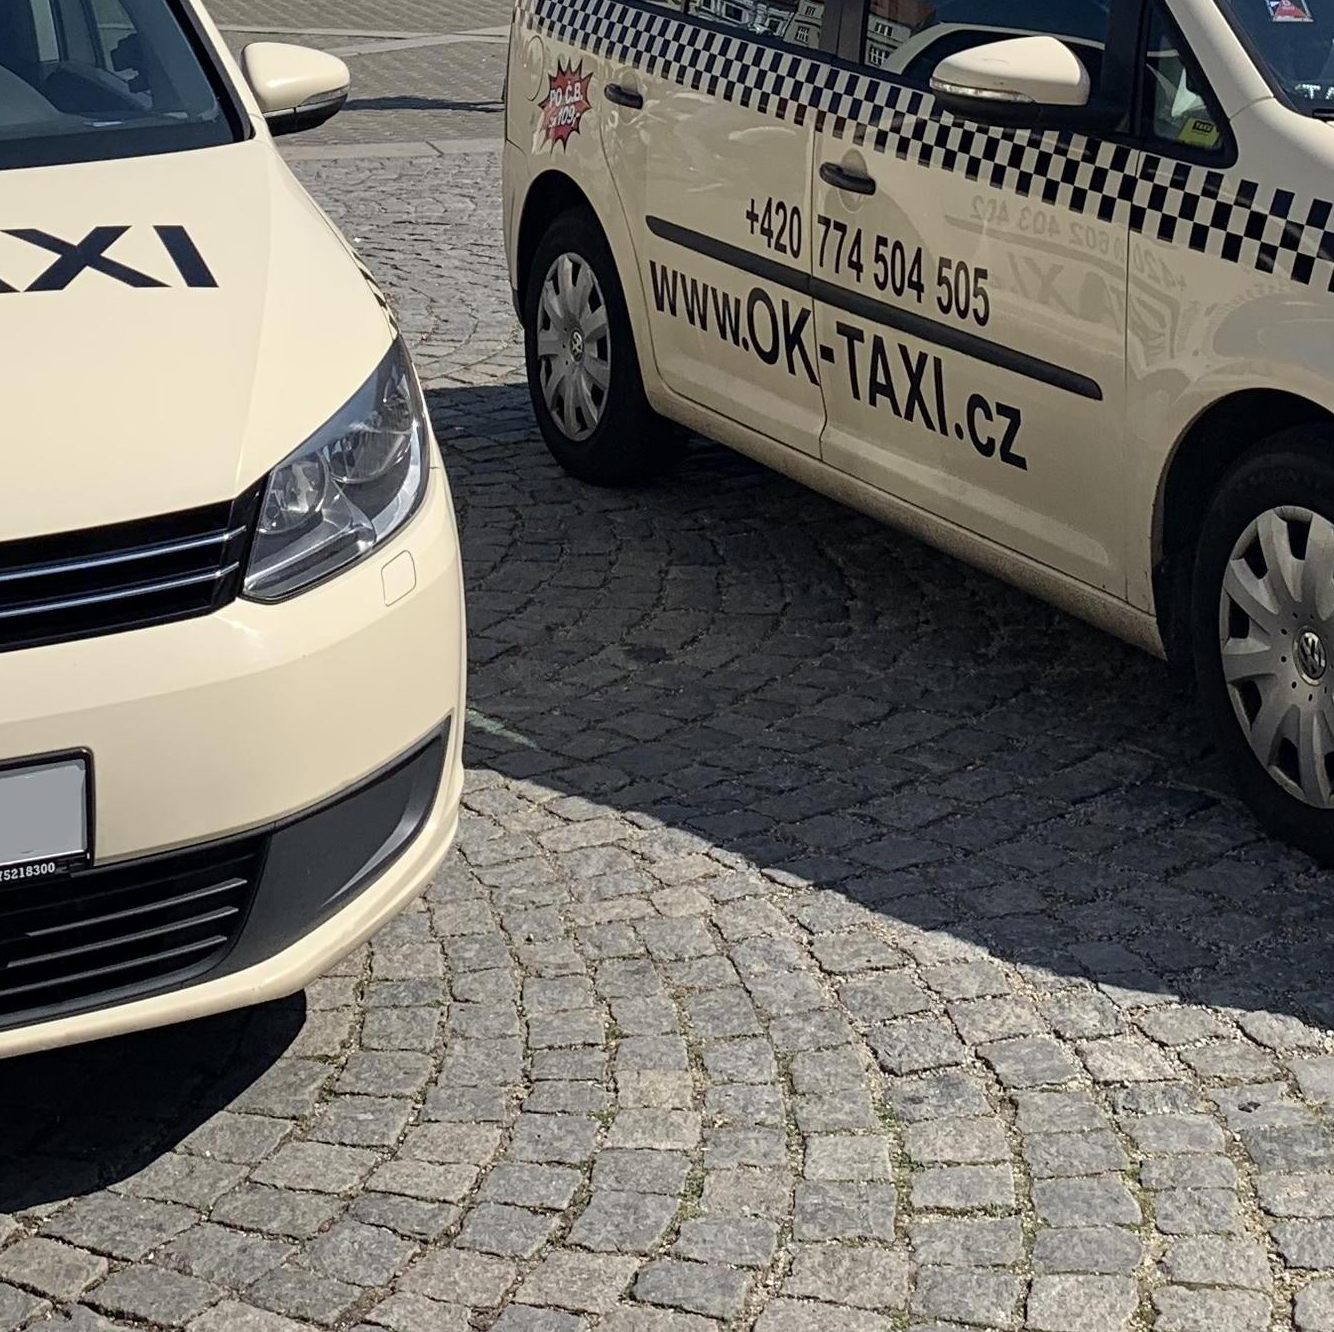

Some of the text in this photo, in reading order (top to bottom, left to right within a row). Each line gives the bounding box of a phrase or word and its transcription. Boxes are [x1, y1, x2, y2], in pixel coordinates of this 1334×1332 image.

[746, 196, 802, 259] +420
[817, 214, 864, 284] 774
[873, 234, 925, 304] 504
[937, 256, 990, 327] 505
